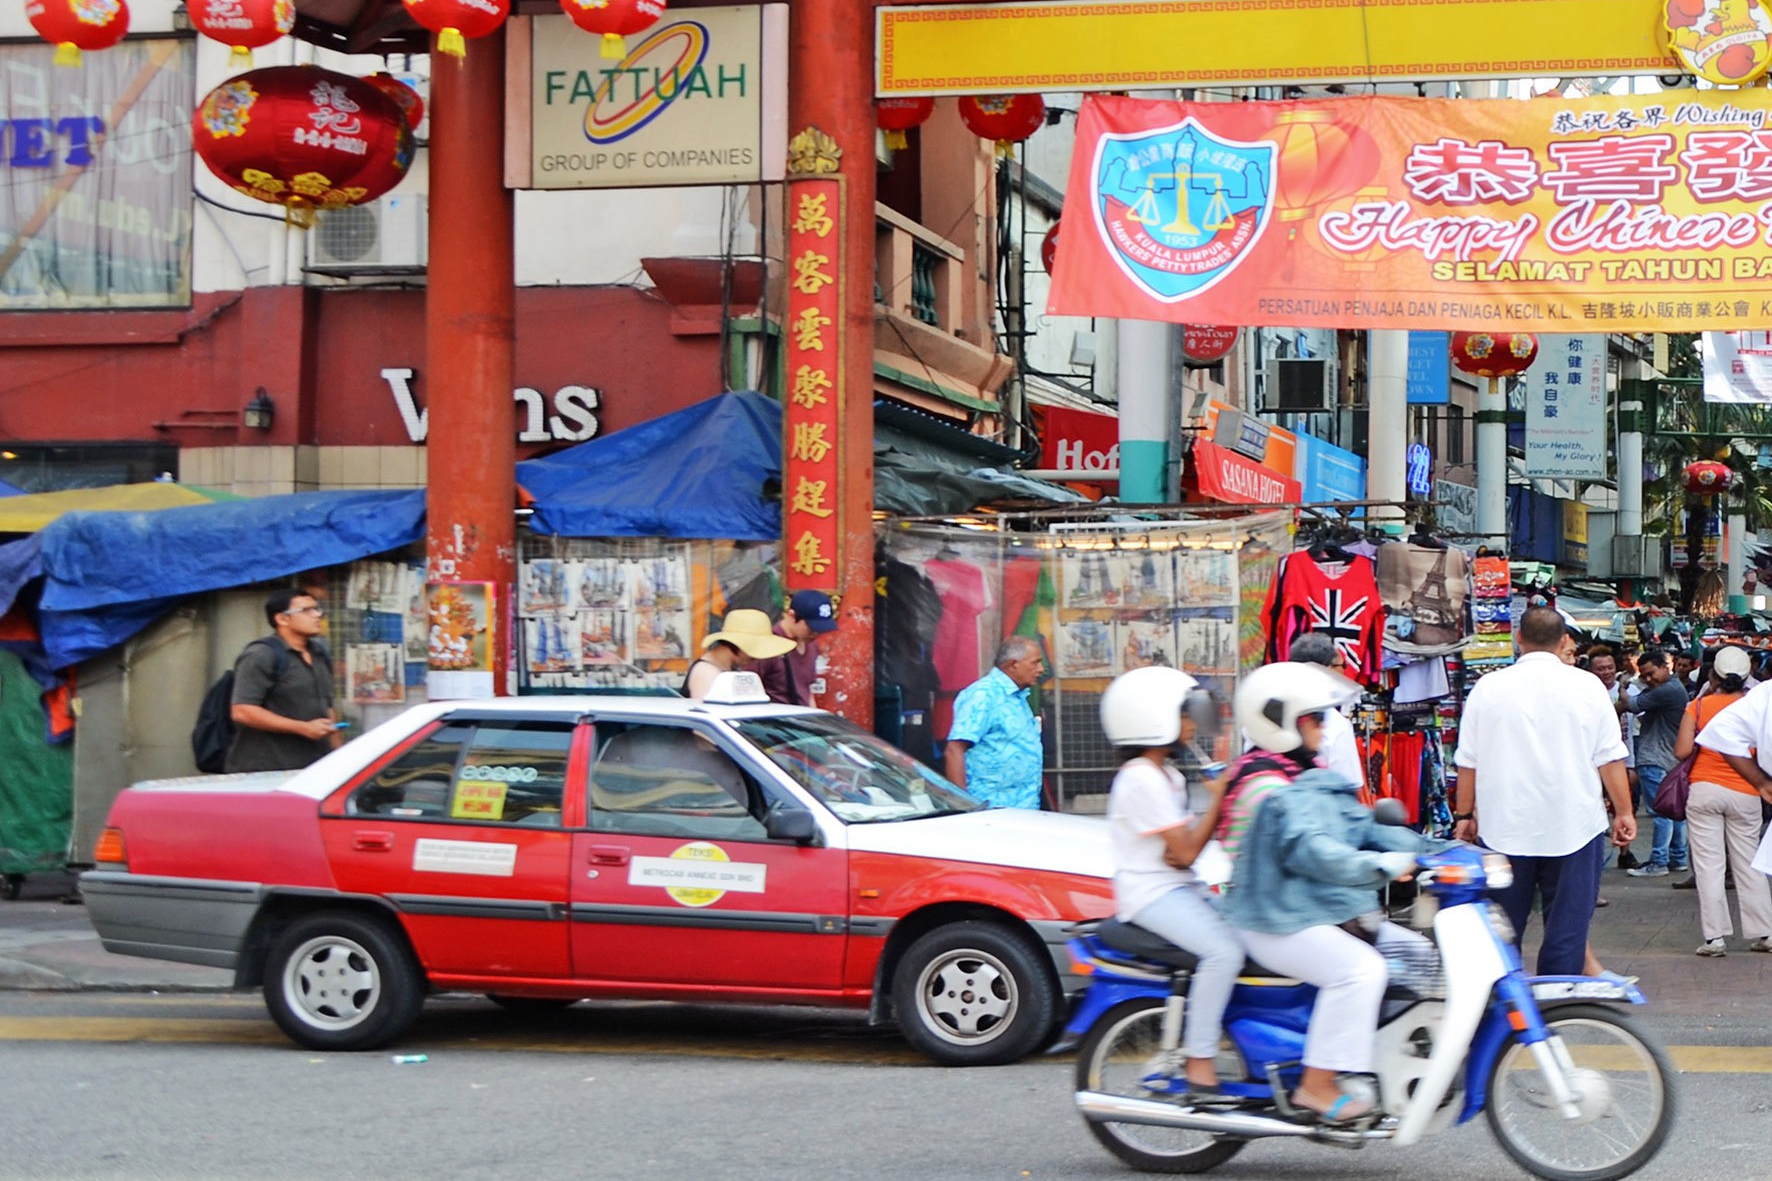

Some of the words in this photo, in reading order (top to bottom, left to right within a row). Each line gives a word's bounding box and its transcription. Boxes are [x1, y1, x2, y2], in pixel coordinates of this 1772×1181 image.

[546, 63, 746, 106] FATTUAH
[1674, 103, 1764, 129] Wishing
[541, 153, 608, 172] GROUP
[612, 152, 637, 169] OF
[643, 148, 753, 168] COMPANIES
[1164, 233, 1199, 248] 1953
[1320, 199, 1537, 268] Happy
[1546, 196, 1758, 255] Chinese
[1134, 231, 1173, 261] KUALA
[1175, 240, 1226, 262] LUMPUR
[1152, 255, 1188, 273] PETTY
[1432, 258, 1591, 283] SELAMAT
[1600, 257, 1723, 281] TAHUN
[1258, 299, 1341, 316] PERSATUAN
[1344, 300, 1403, 317] PENJAJA
[1408, 301, 1436, 317] DAN
[1440, 303, 1501, 319] PENIAGA
[1505, 304, 1544, 319] KECIL
[1528, 441, 1549, 450] Your
[1554, 453, 1568, 461] My
